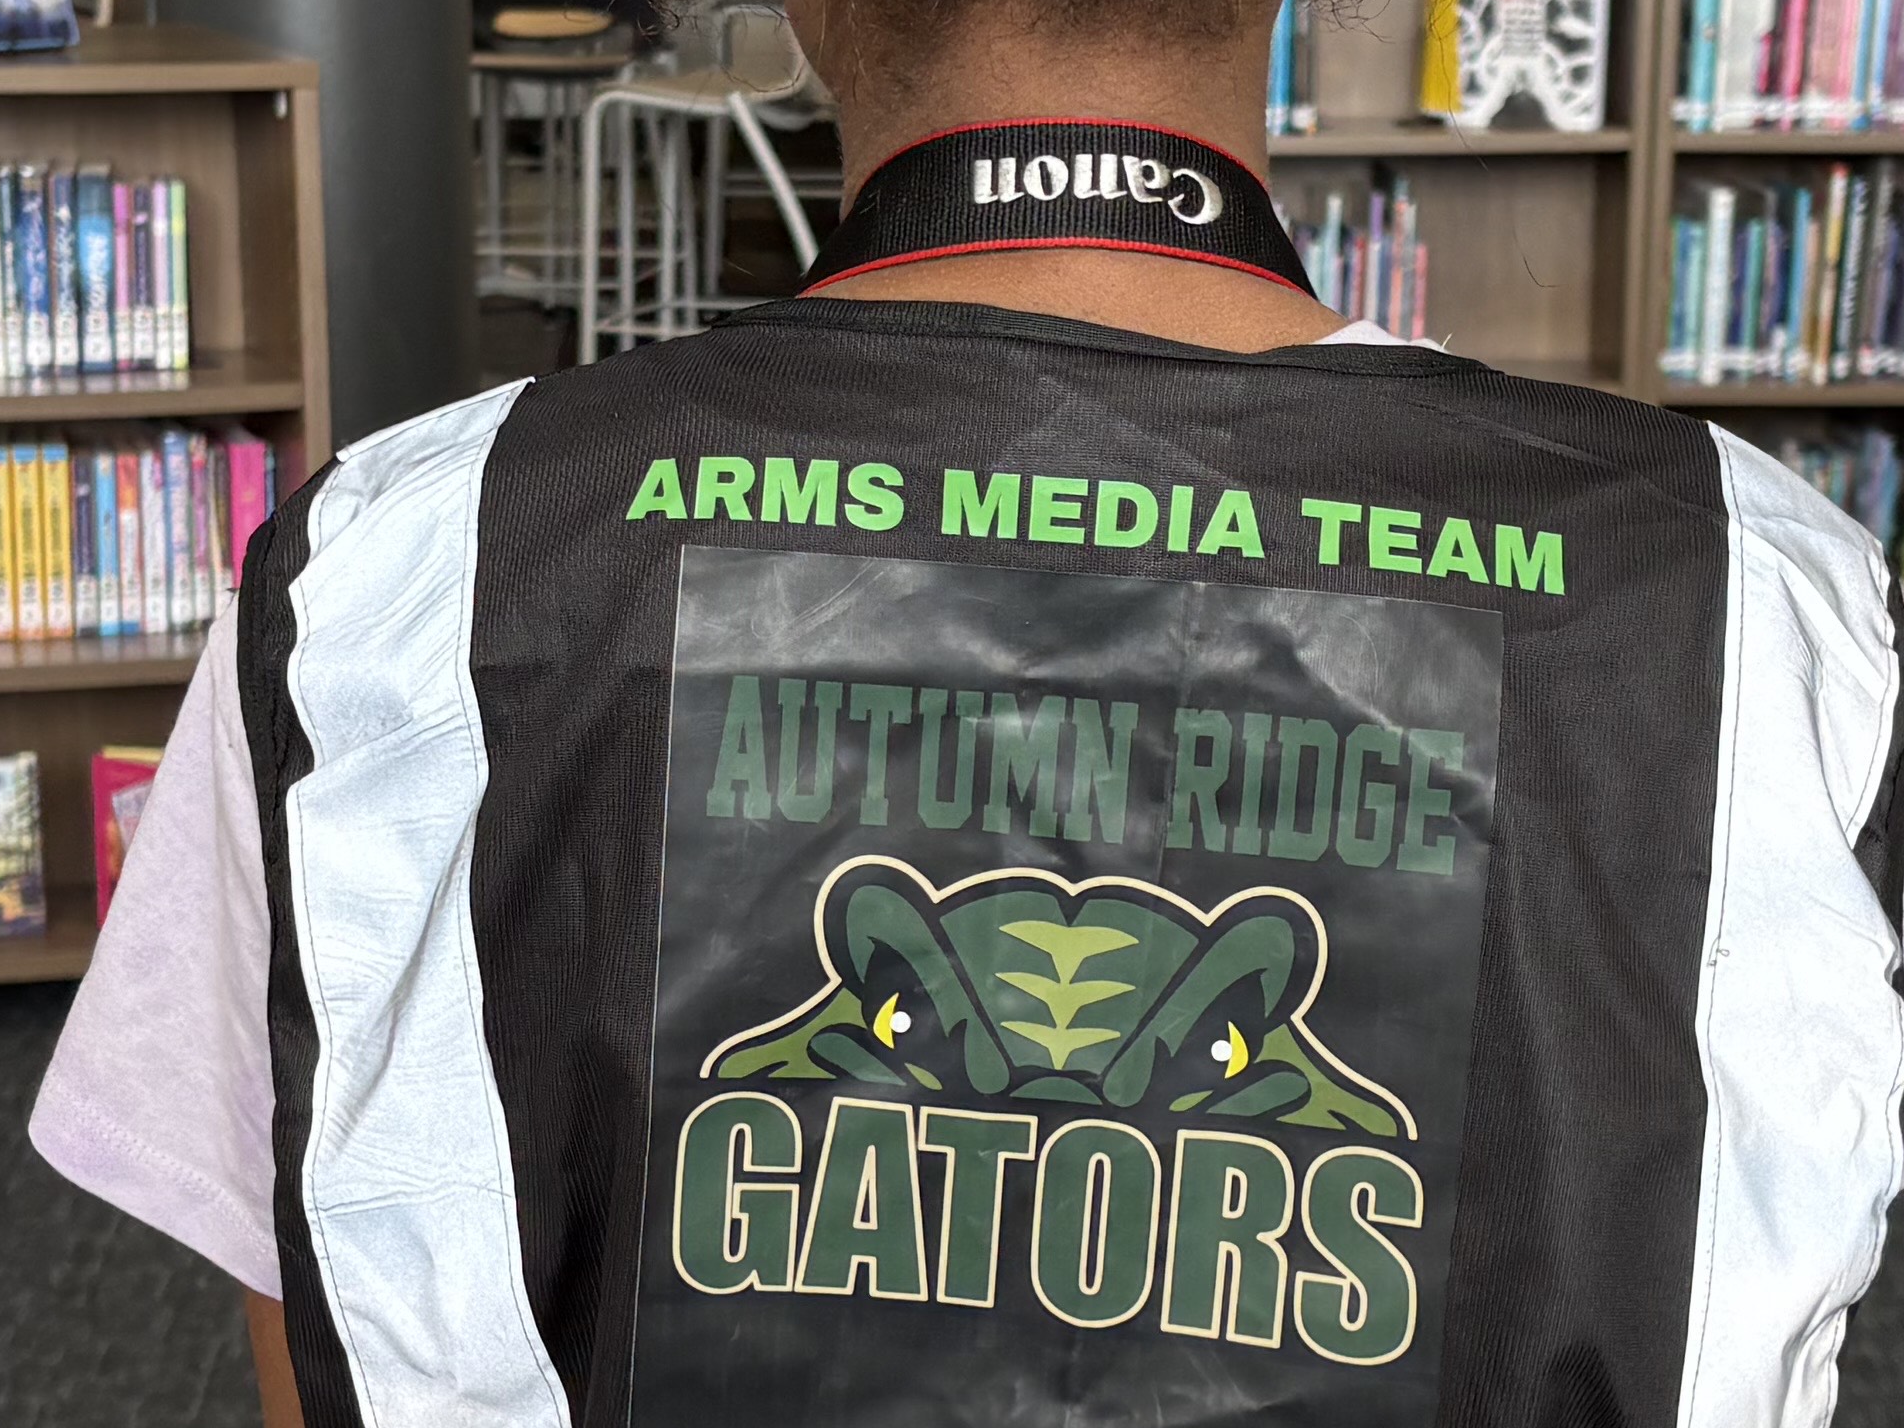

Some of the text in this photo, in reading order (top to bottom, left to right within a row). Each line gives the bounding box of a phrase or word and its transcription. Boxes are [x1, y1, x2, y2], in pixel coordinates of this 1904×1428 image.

[973, 153, 1223, 225] Canon
[626, 456, 1566, 595] ARMS MEDIA TEAM
[706, 674, 1466, 876] AUTUMN RIDGE
[672, 1090, 1423, 1366] GATORS
